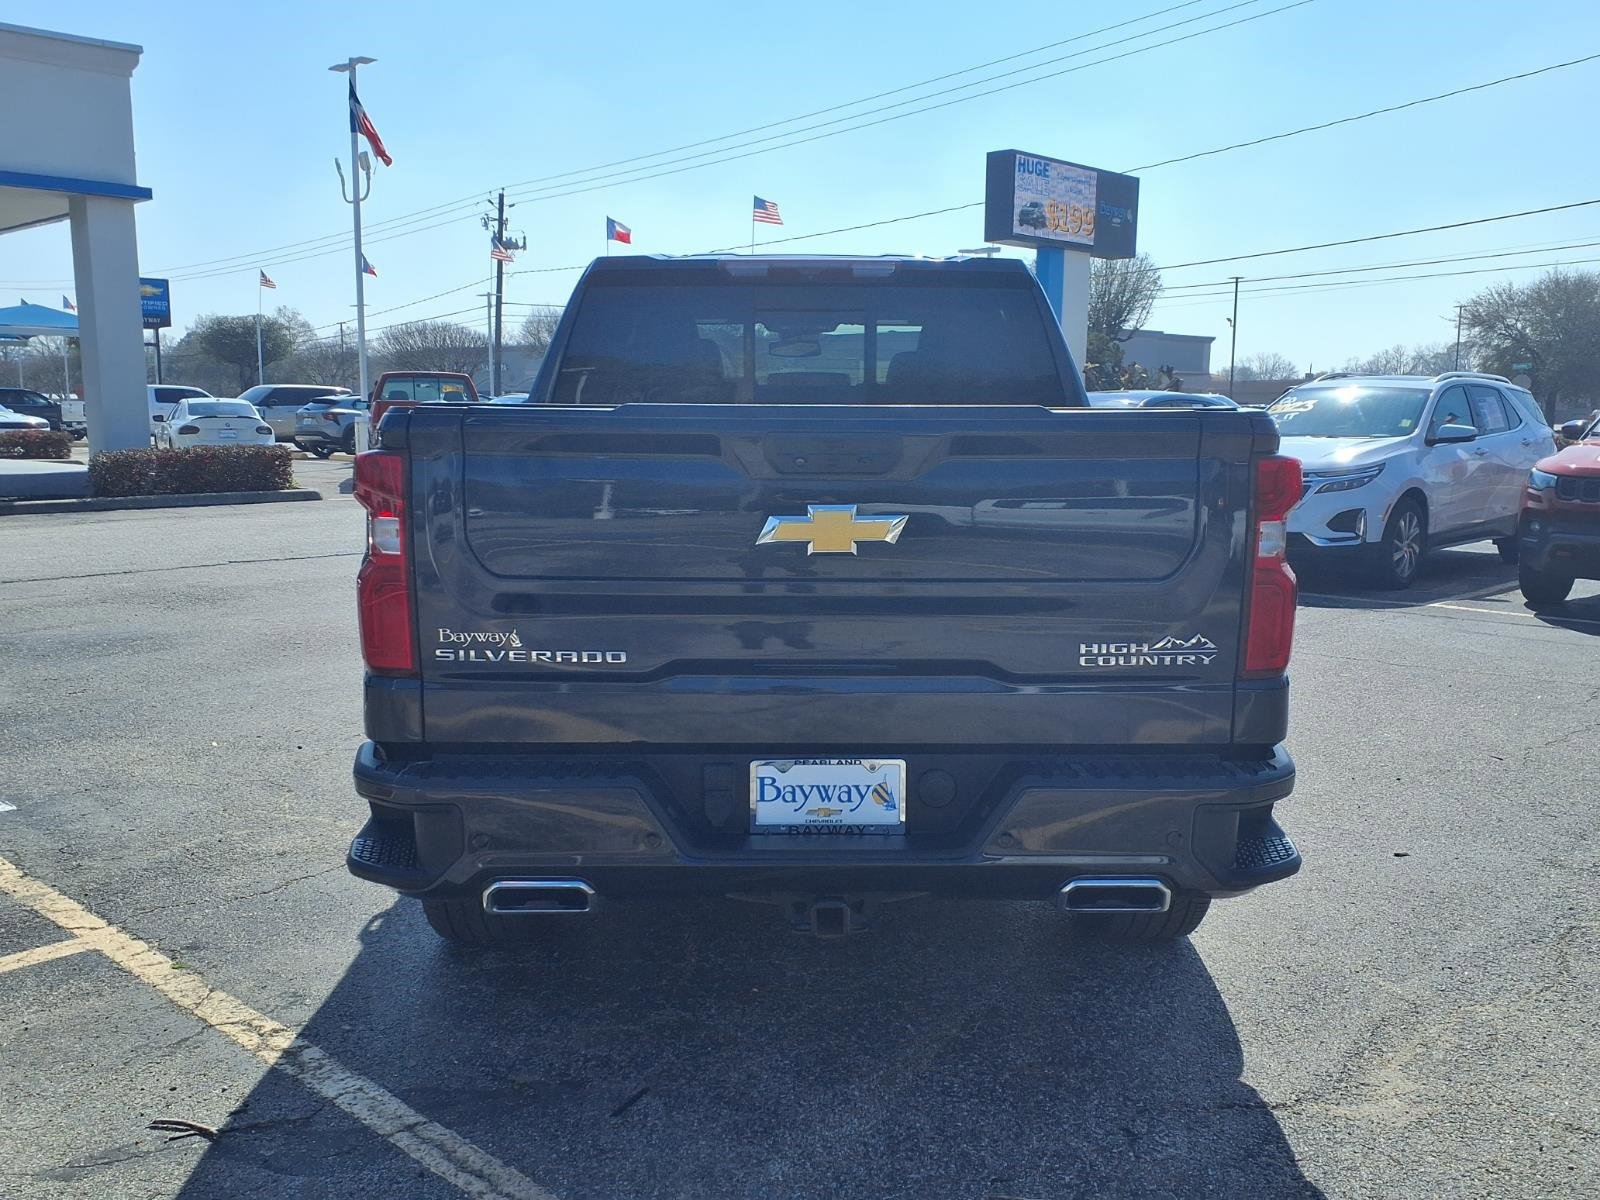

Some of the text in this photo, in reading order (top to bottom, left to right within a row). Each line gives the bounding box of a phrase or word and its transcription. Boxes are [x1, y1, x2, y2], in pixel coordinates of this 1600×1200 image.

[1017, 156, 1050, 178] HUGE
[438, 628, 509, 647] Bayway
[1079, 643, 1149, 654] HIGH
[435, 649, 627, 663] SILVERADO
[1079, 655, 1217, 667] COUNTRY
[756, 776, 873, 812] Bayway
[789, 825, 866, 835] BAYWAY
